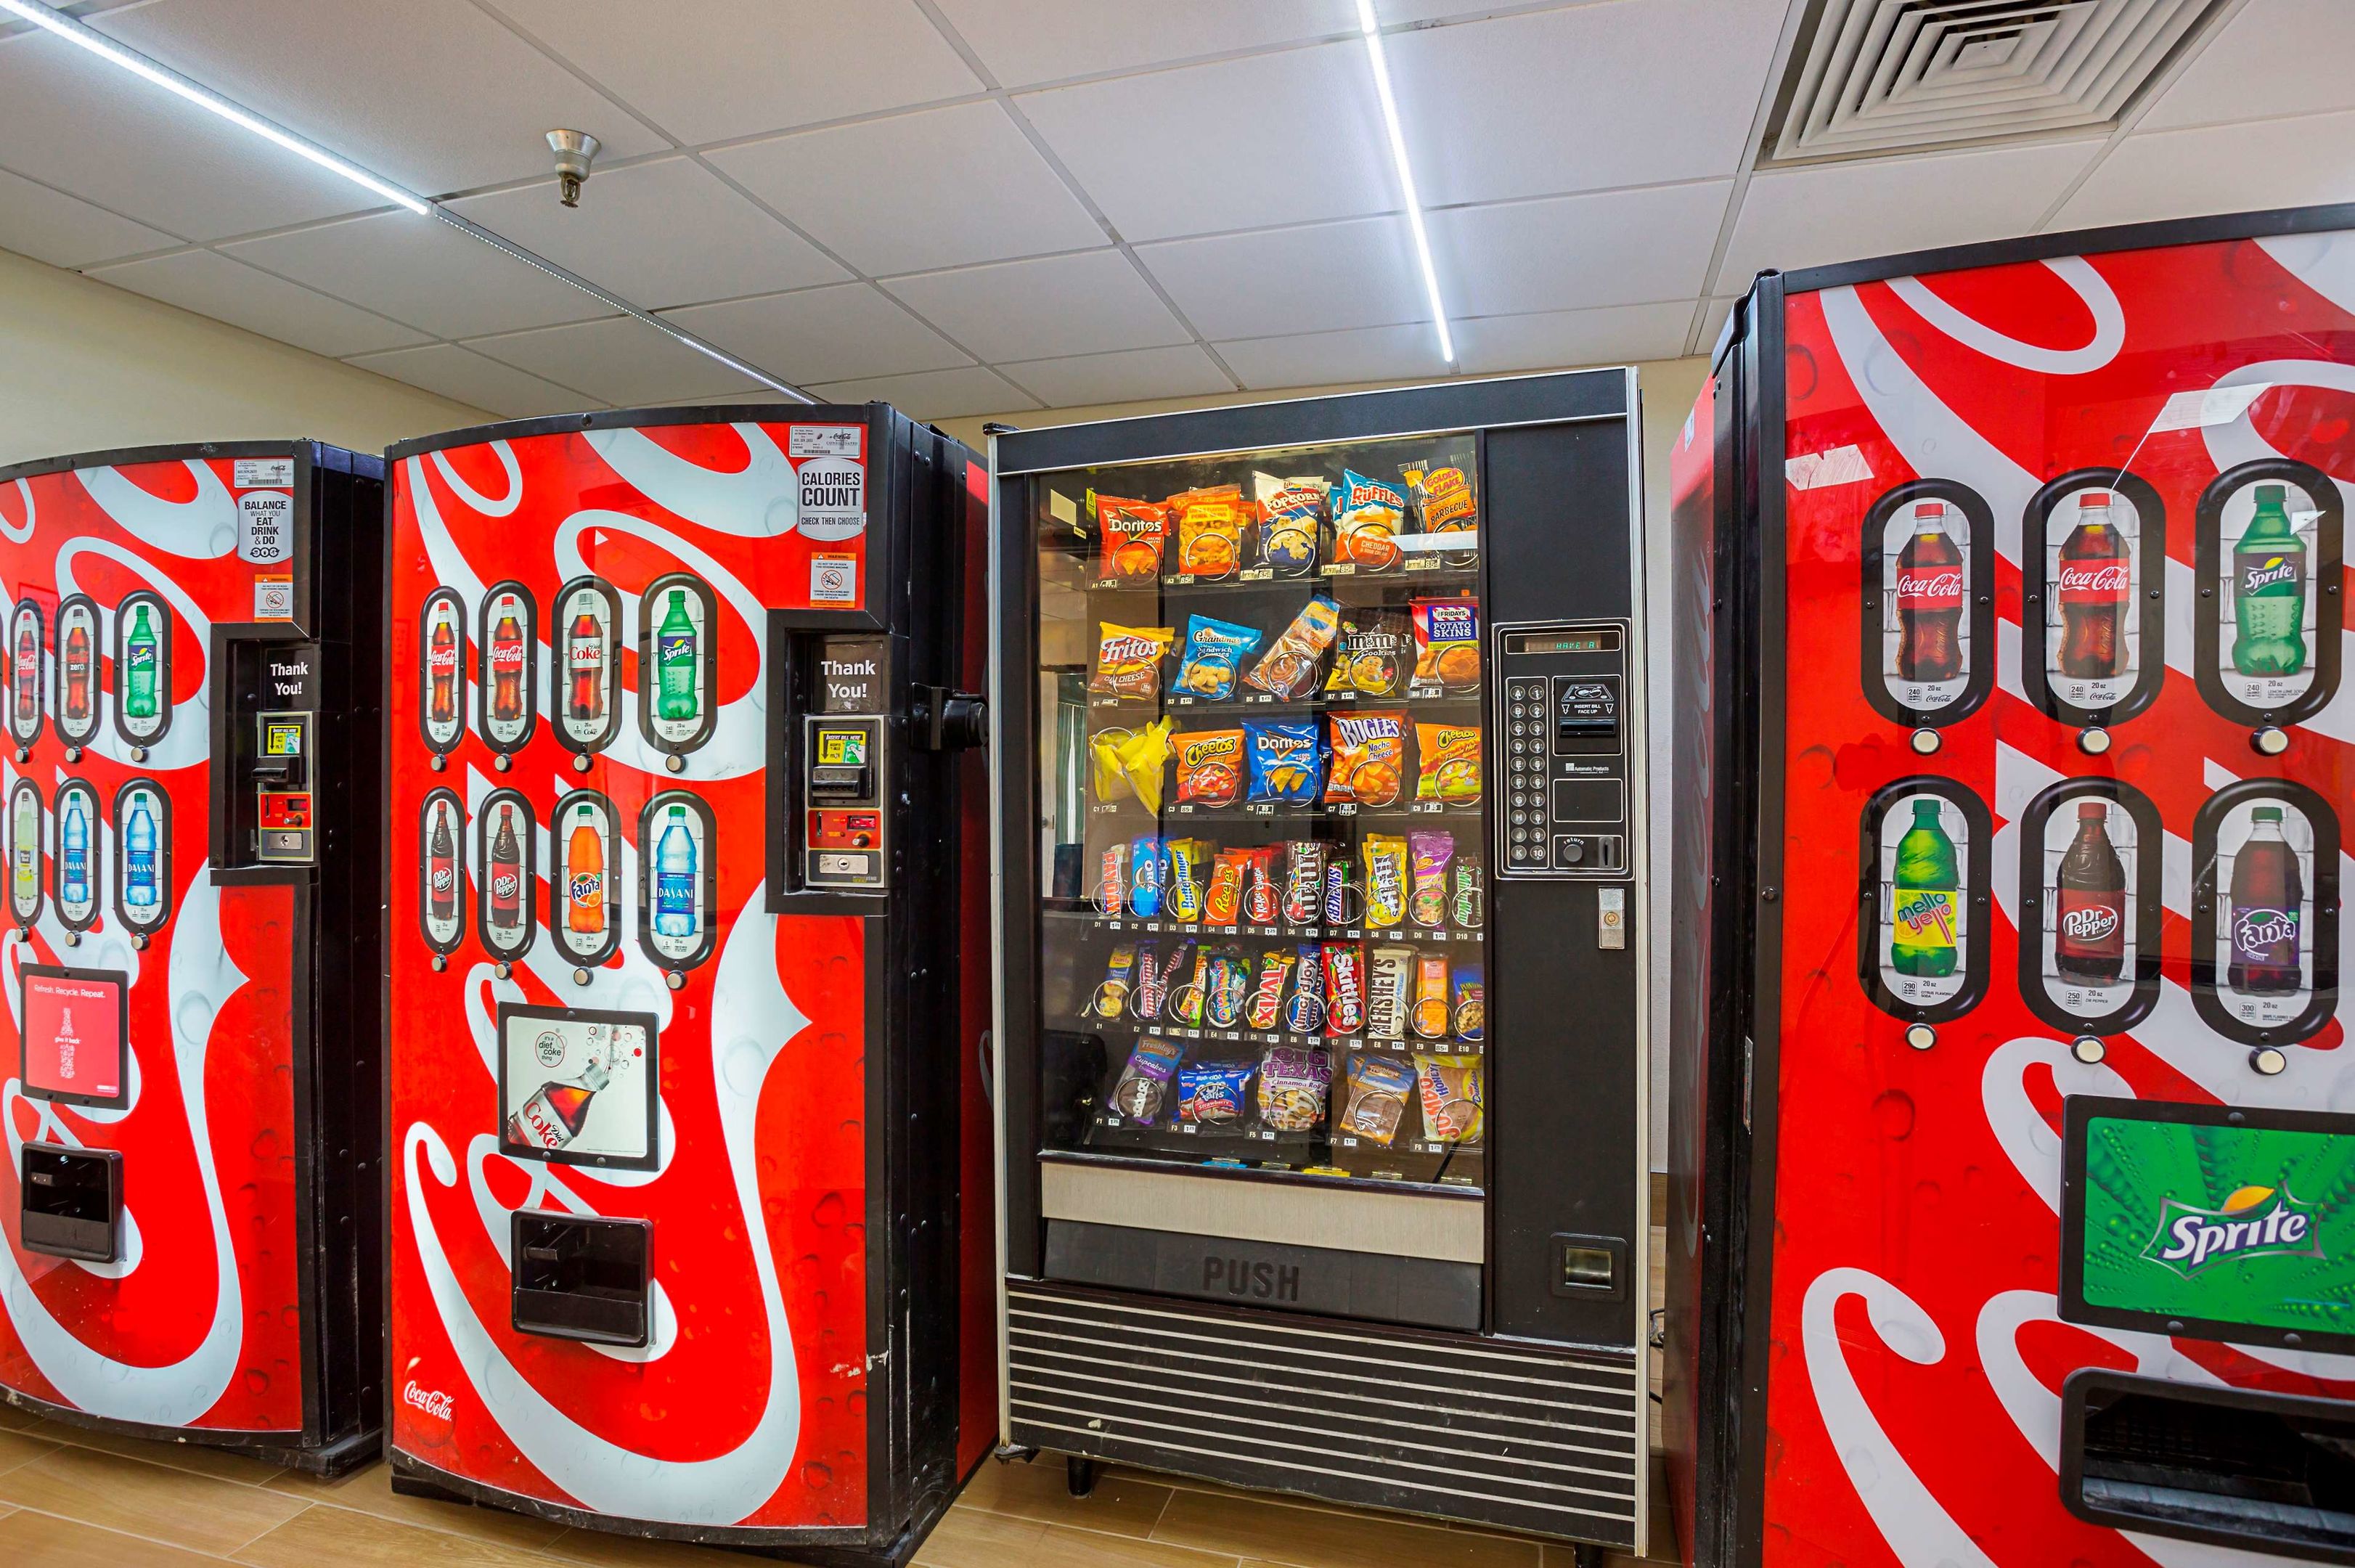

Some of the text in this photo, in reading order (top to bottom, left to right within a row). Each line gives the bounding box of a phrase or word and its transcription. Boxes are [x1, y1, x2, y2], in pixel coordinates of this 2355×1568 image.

[801, 472, 860, 486] CALORIES
[1427, 468, 1458, 487] GOLDEN
[1433, 477, 1461, 497] FLAKE
[801, 487, 860, 507] COUNT
[1265, 492, 1321, 513] POPCORN
[1352, 486, 1404, 507] RUFFLES
[245, 501, 286, 510] BALANCE
[1430, 499, 1468, 526] BARBECUE
[801, 517, 860, 526] CHECK THEN CHOOSE
[1109, 518, 1162, 533] Doritos
[251, 526, 279, 535] DRINK
[263, 536, 275, 544] DO
[1360, 540, 1390, 551] CHEDDAR
[1897, 572, 1962, 597] Coca-Cola
[2060, 565, 2129, 592] Coca-Cola
[2245, 563, 2293, 589] Sprite
[1434, 629, 1472, 637] SKINS
[569, 646, 601, 661] Coke
[663, 644, 690, 661] Sprite
[1101, 635, 1159, 663] Fritos
[131, 653, 153, 666] Sprite
[821, 660, 876, 676] Thank
[270, 662, 308, 677] Thank
[274, 682, 302, 695] You!
[828, 683, 868, 698] You!
[2089, 692, 2117, 701] Coca-Cola
[1338, 717, 1400, 748] BUGLES
[1437, 730, 1477, 749] Cheetos
[1258, 736, 1313, 751] Doritos
[1368, 742, 1390, 752] Nacho
[1185, 738, 1236, 767] Cheetos
[1368, 749, 1394, 760] Cheese
[1563, 836, 1585, 845] return
[65, 862, 86, 870] DASANI
[128, 864, 155, 873] DASANI
[494, 878, 516, 895] Pepper
[1175, 849, 1194, 909] Butterfinger
[658, 886, 693, 899] DASANI
[1897, 892, 1946, 922] mello
[1908, 903, 1954, 944] yello
[2067, 911, 2115, 937] Pepper
[2081, 910, 2103, 924] Dr
[81, 989, 106, 999] Repeat.
[1256, 964, 1286, 1024] TWIX
[1333, 954, 1358, 1027] Skittles
[1371, 958, 1396, 1034] HERSHEY'S
[1135, 1054, 1167, 1073] Cupcakes
[1270, 1047, 1329, 1067] BIG
[1262, 1062, 1334, 1082] TEXAS
[1271, 1079, 1307, 1088] Cinnamon
[1199, 1101, 1230, 1109] Strawberry
[524, 1101, 558, 1150] Coke
[2162, 1199, 2309, 1266] Sprite
[1201, 1257, 1300, 1302] PUSH
[404, 1379, 454, 1421] Coca-Cola
